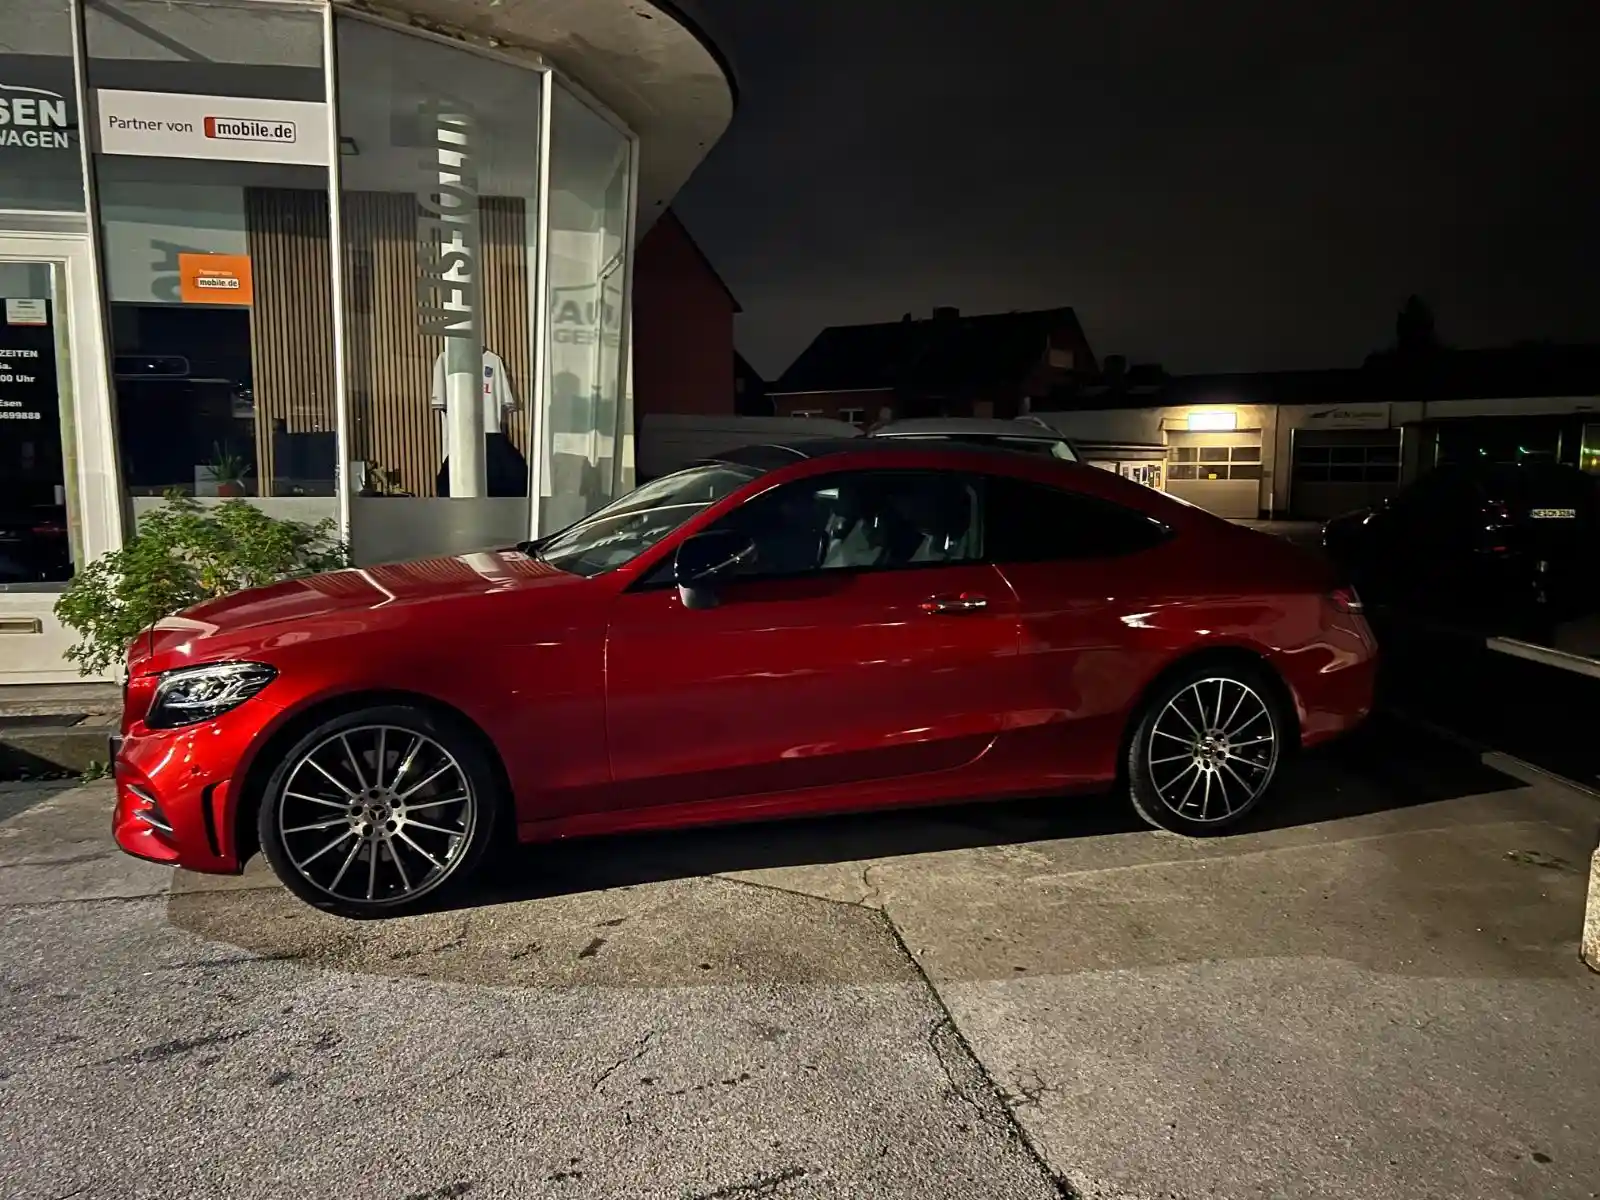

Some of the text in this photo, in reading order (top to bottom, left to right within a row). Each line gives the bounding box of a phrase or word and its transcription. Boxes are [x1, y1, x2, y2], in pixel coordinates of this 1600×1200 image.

[109, 116, 293, 138] Partner von mobile.de
[199, 278, 238, 288] mobile.de
[0, 349, 38, 358] ZEITEN
[16, 375, 36, 383] Uhr
